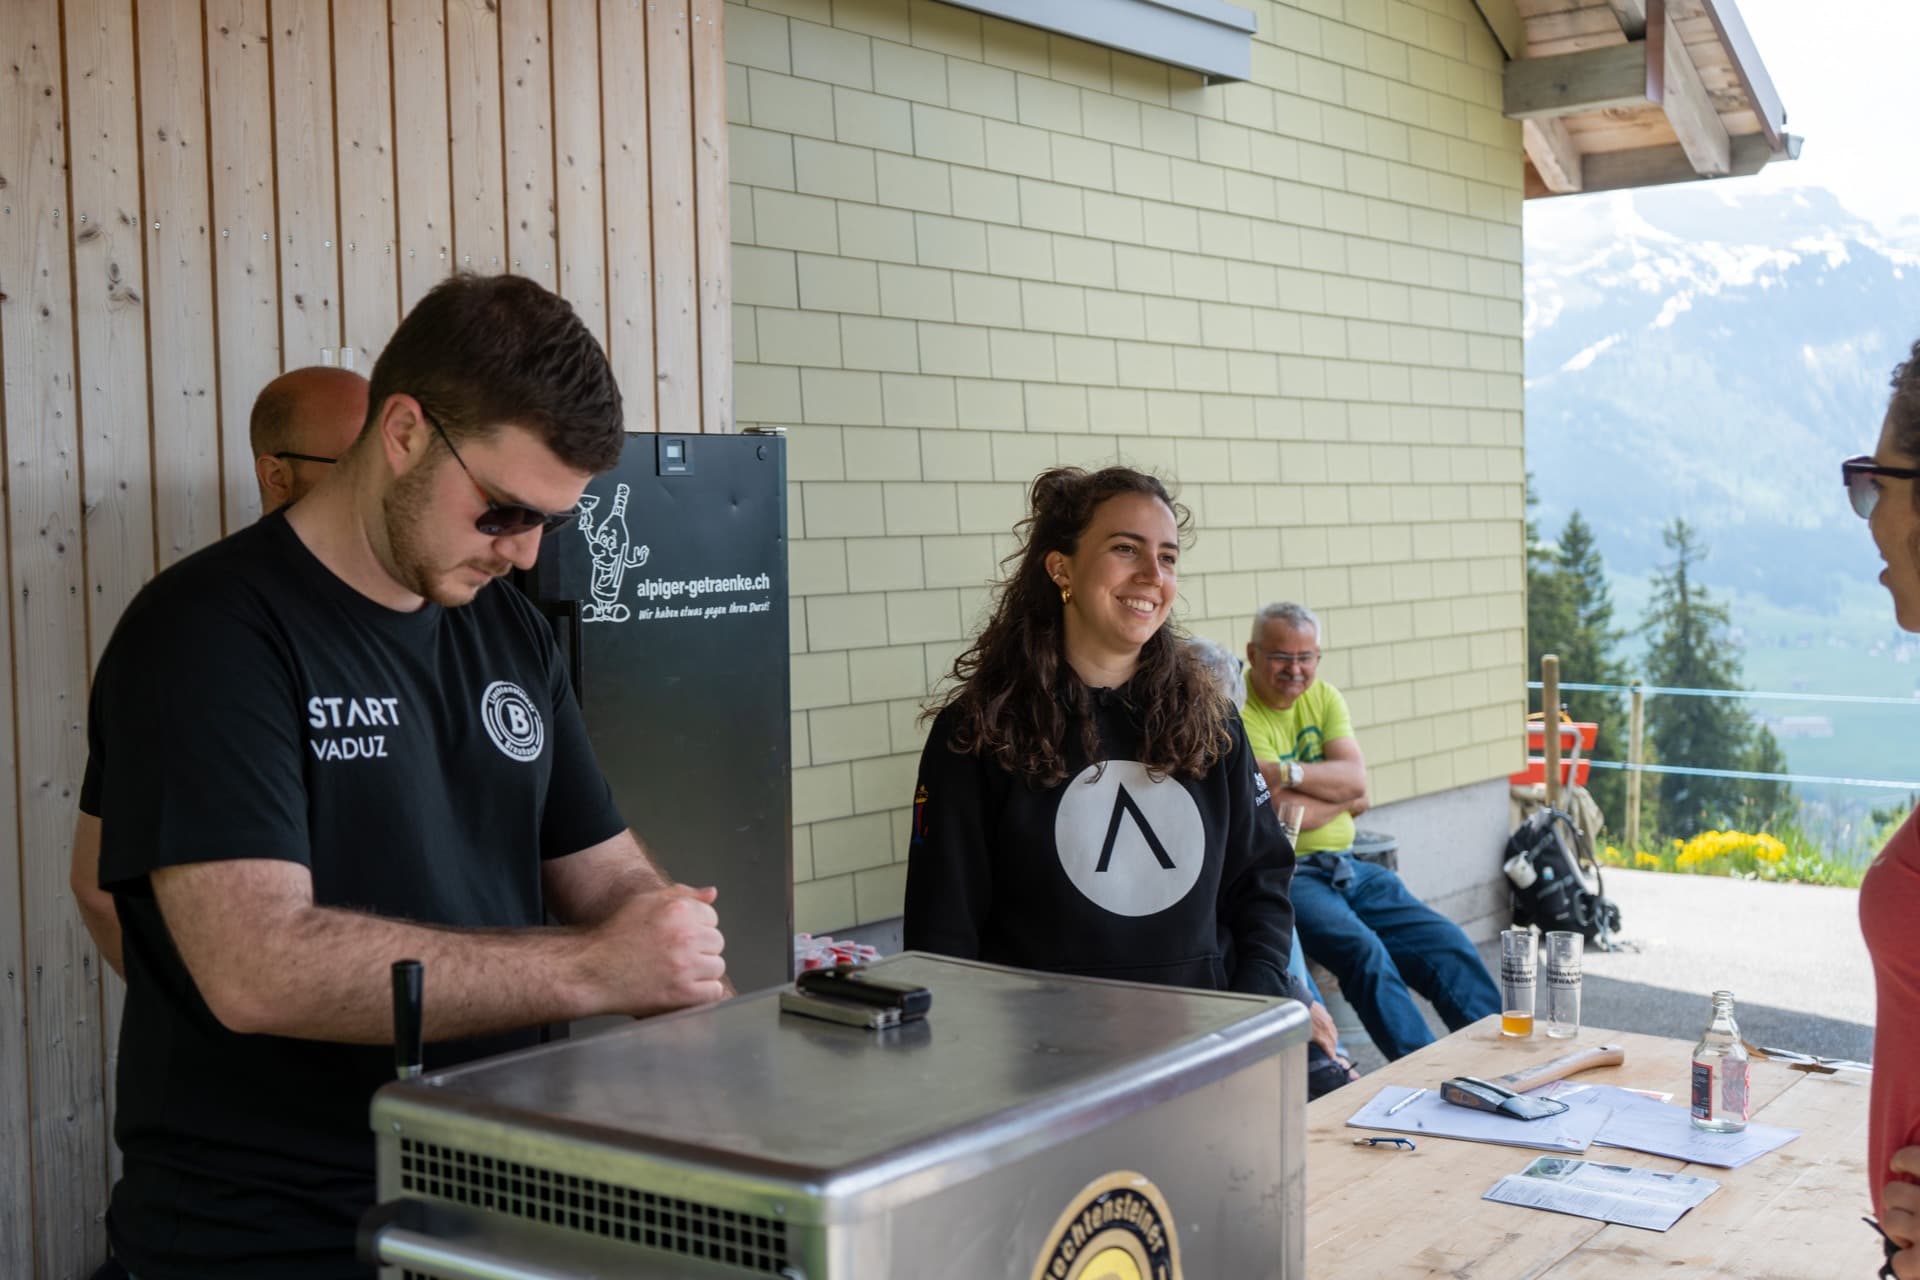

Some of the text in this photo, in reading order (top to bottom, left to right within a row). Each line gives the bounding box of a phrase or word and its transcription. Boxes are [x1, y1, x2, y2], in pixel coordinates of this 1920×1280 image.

[637, 572, 770, 600] alpiger-getraenke.ch
[638, 608, 654, 620] Wir
[655, 606, 679, 619] haben
[680, 605, 703, 617] etwas
[703, 606, 727, 619] gegen
[307, 696, 400, 729] START
[505, 703, 530, 735] B
[309, 735, 389, 761] VADUZ
[1045, 1192, 1165, 1280] echtensteiner
